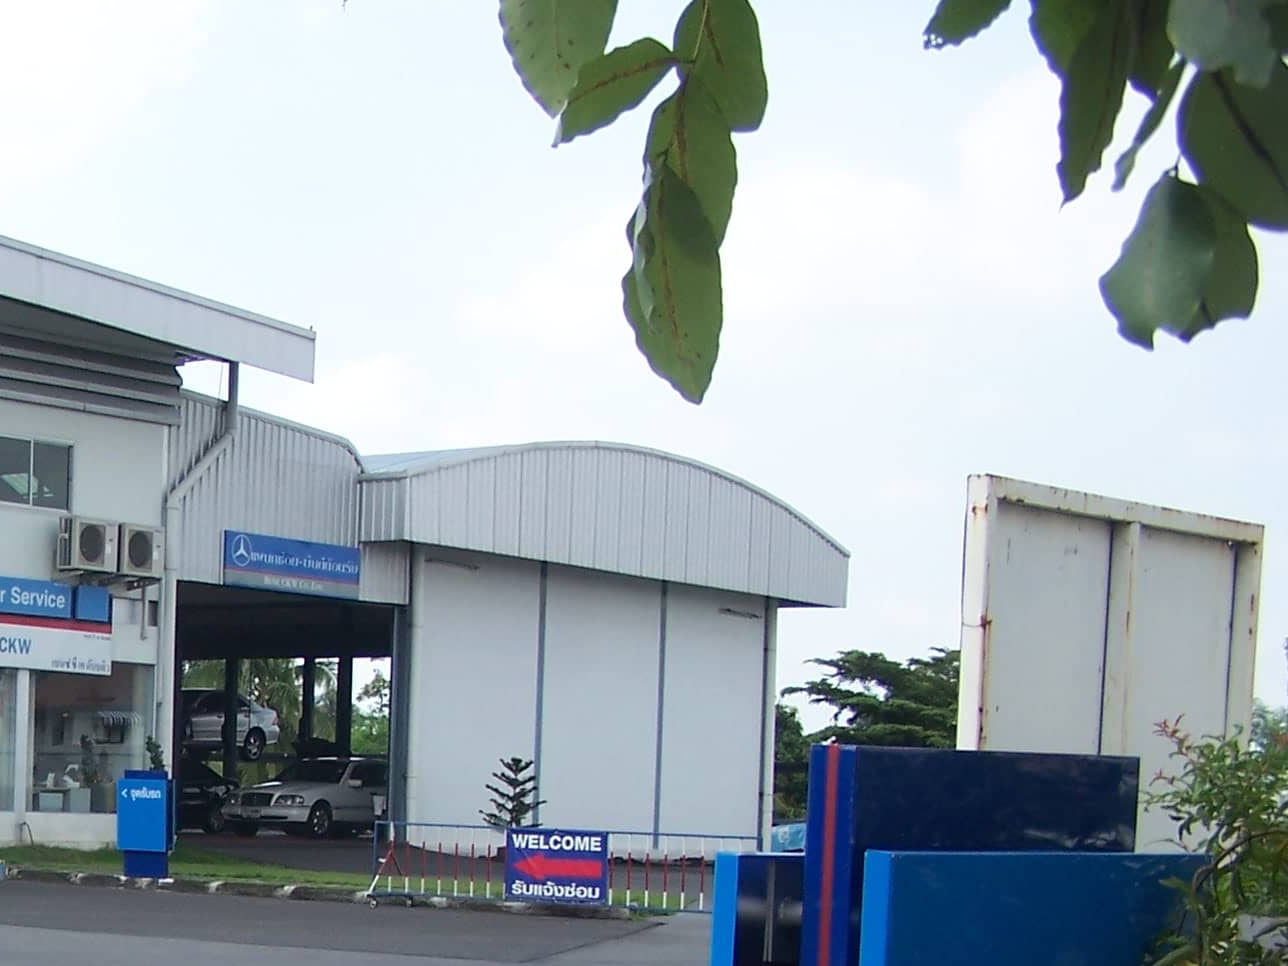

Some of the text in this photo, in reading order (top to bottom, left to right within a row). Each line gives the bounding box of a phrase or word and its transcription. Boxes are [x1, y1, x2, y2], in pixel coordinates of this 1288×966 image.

[10, 587, 65, 608] Service
[512, 834, 602, 852] WELCOME
[511, 880, 601, 899] รับแจ้งซ่อม
